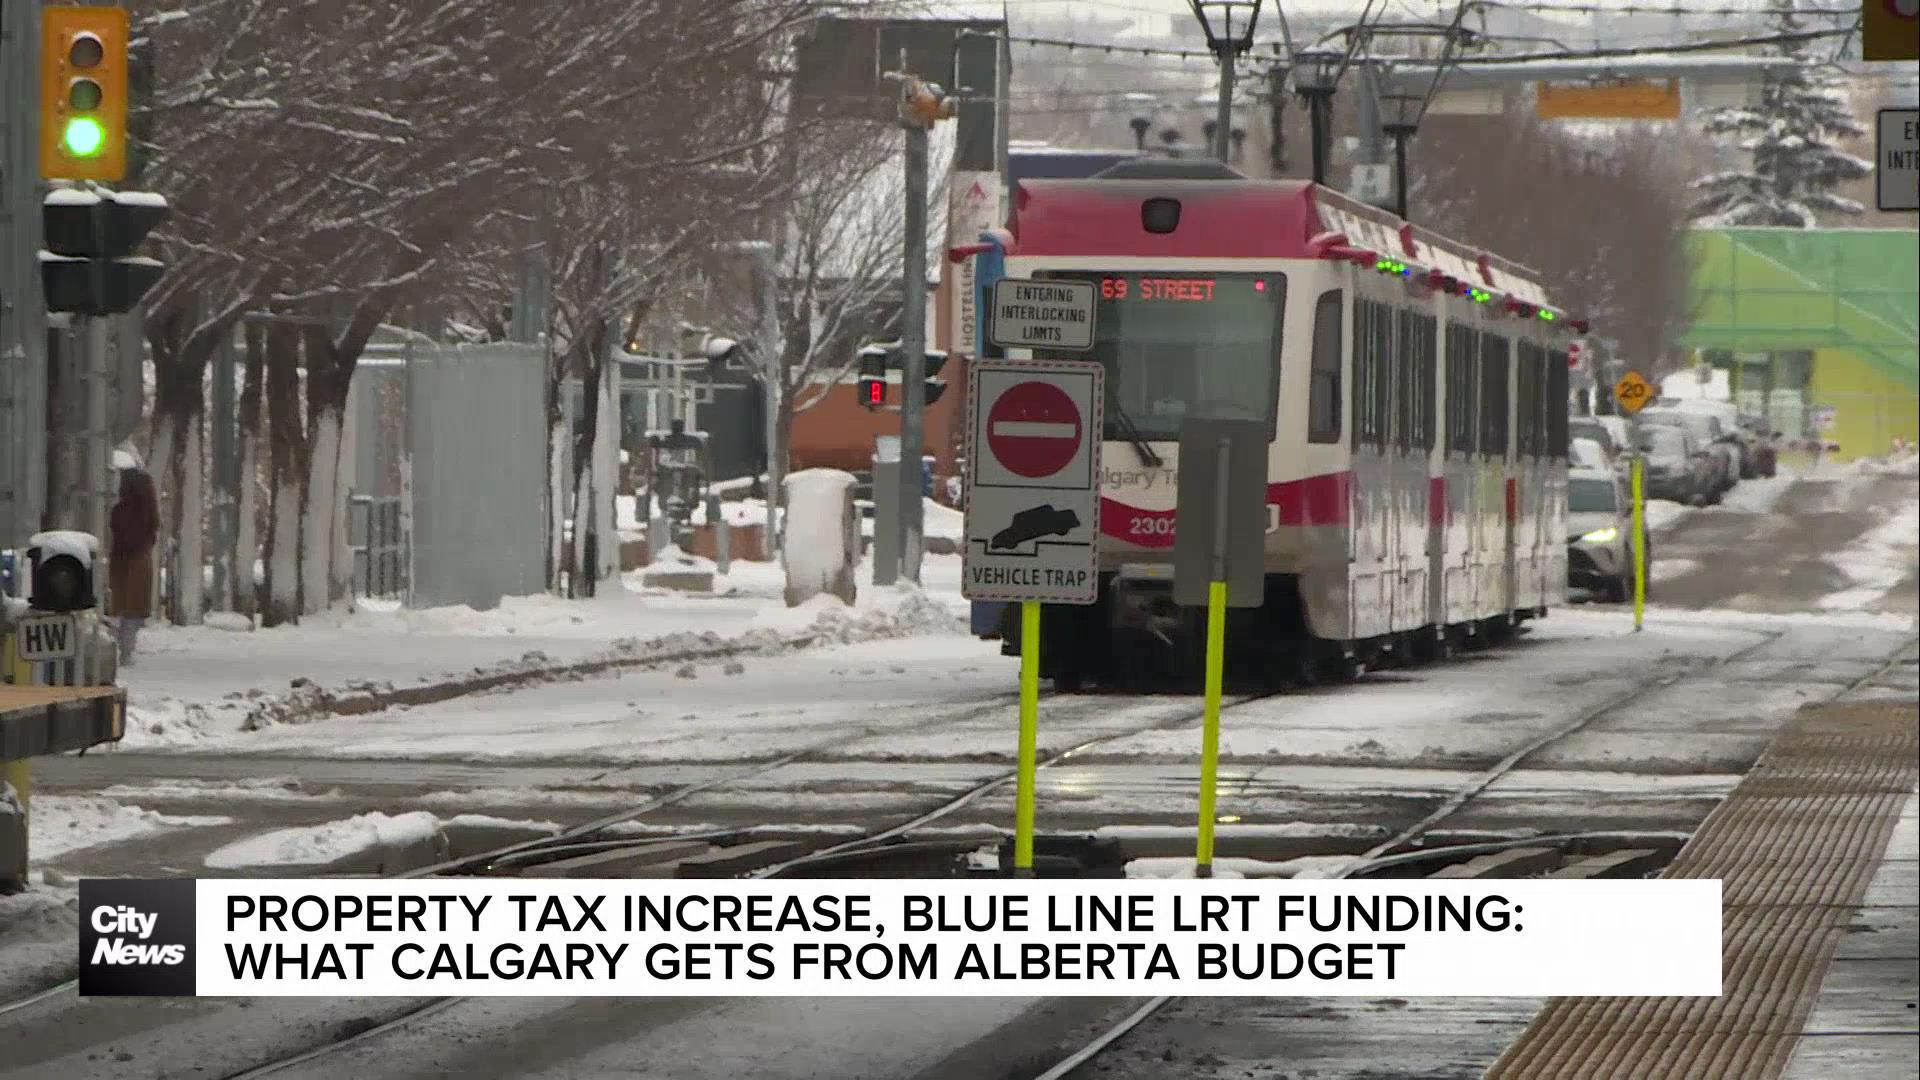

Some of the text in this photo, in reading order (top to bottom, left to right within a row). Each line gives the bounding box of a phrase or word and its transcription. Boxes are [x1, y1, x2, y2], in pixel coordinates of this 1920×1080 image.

[1016, 286, 1073, 303] ENTERING
[1102, 279, 1216, 300] 69 STREET
[1001, 305, 1086, 323] INTERLOCKING
[1022, 326, 1062, 341] LIMITS
[1620, 381, 1645, 398] 20
[973, 567, 1086, 586] VEHICLE TRAP
[26, 623, 66, 652] HW
